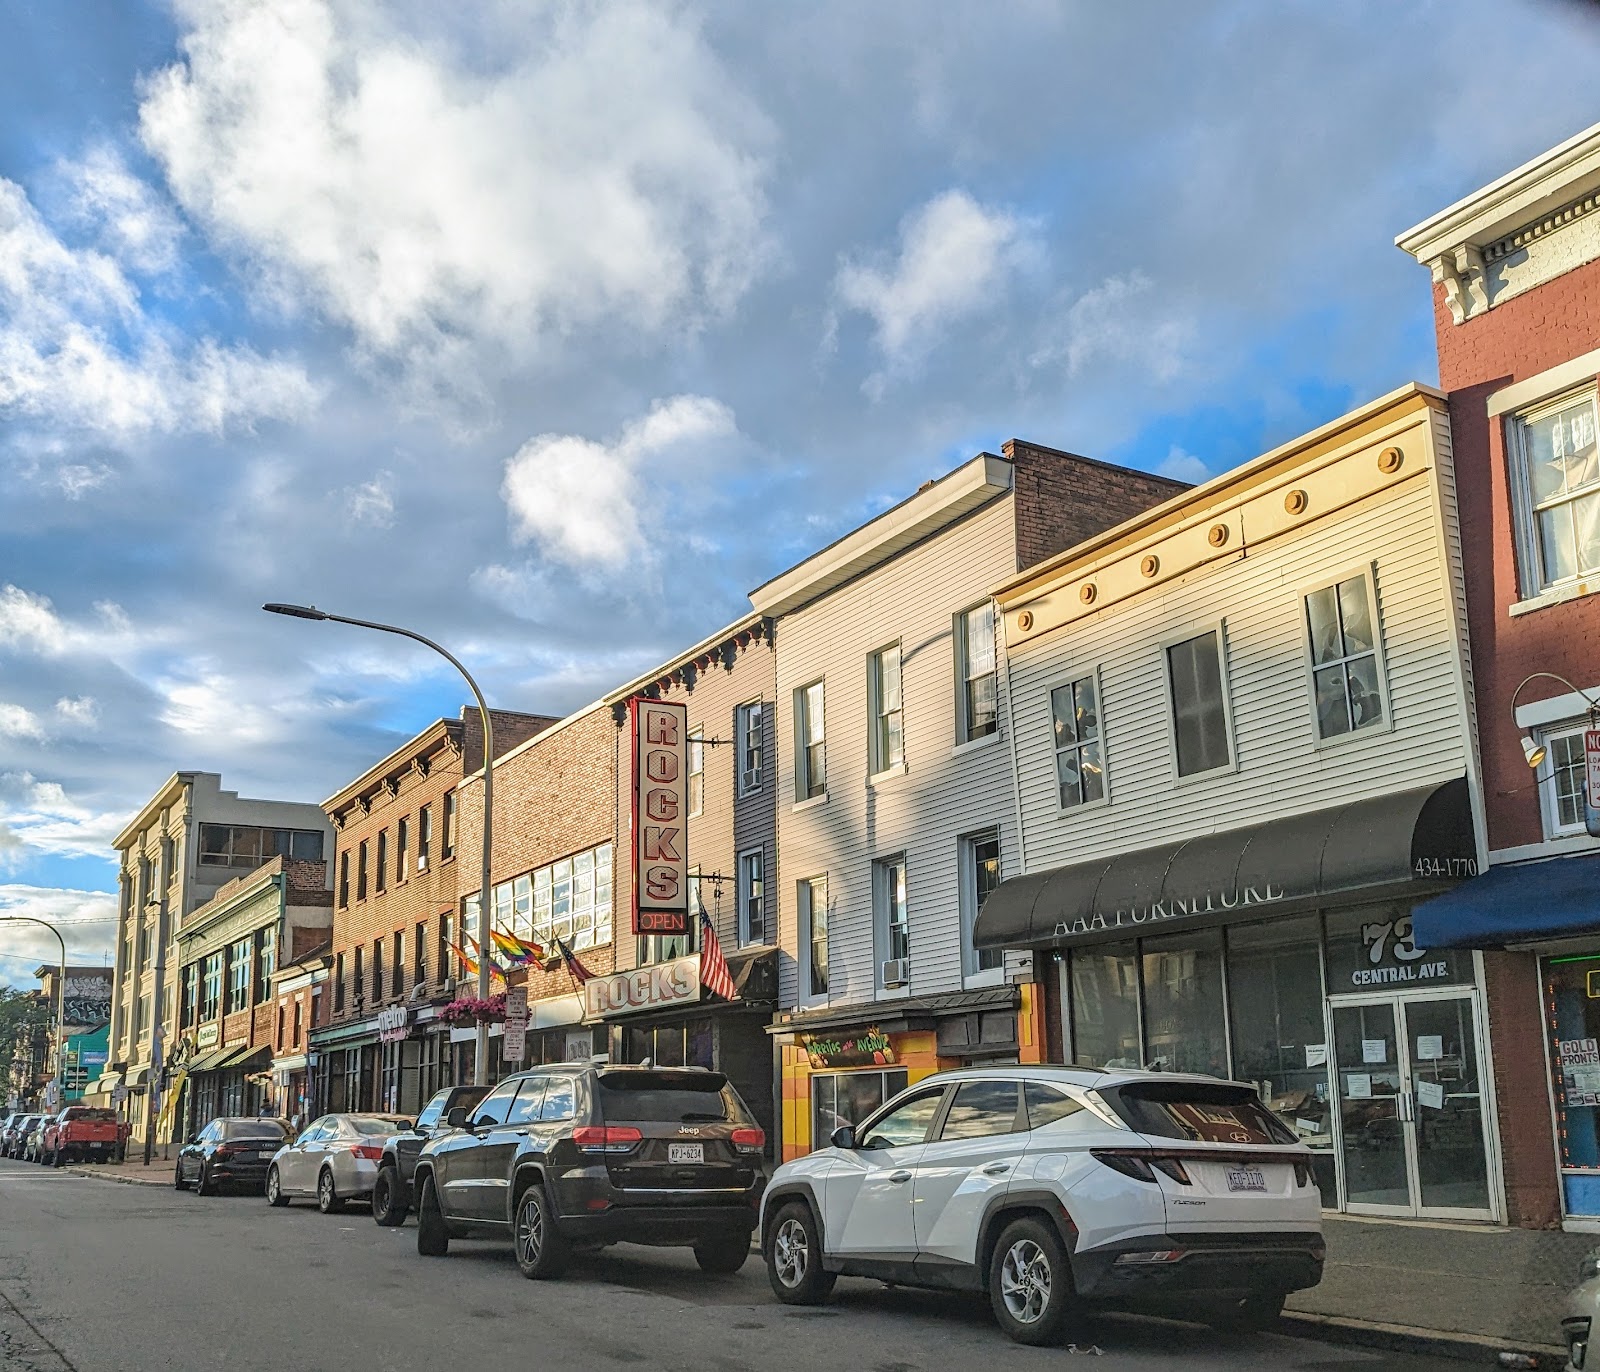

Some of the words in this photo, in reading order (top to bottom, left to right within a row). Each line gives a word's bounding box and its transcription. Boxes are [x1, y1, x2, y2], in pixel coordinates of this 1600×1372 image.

[644, 710, 682, 900] ROCKS
[1415, 857, 1477, 877] 434-1770
[641, 913, 684, 930] OPEN
[1351, 965, 1416, 986] CENTRAL
[588, 961, 697, 1015] ROCKS
[378, 1004, 407, 1030] metro
[1563, 1040, 1595, 1054] GOLD
[1562, 1052, 1599, 1065] FRONTS
[678, 1125, 700, 1135] Jeep
